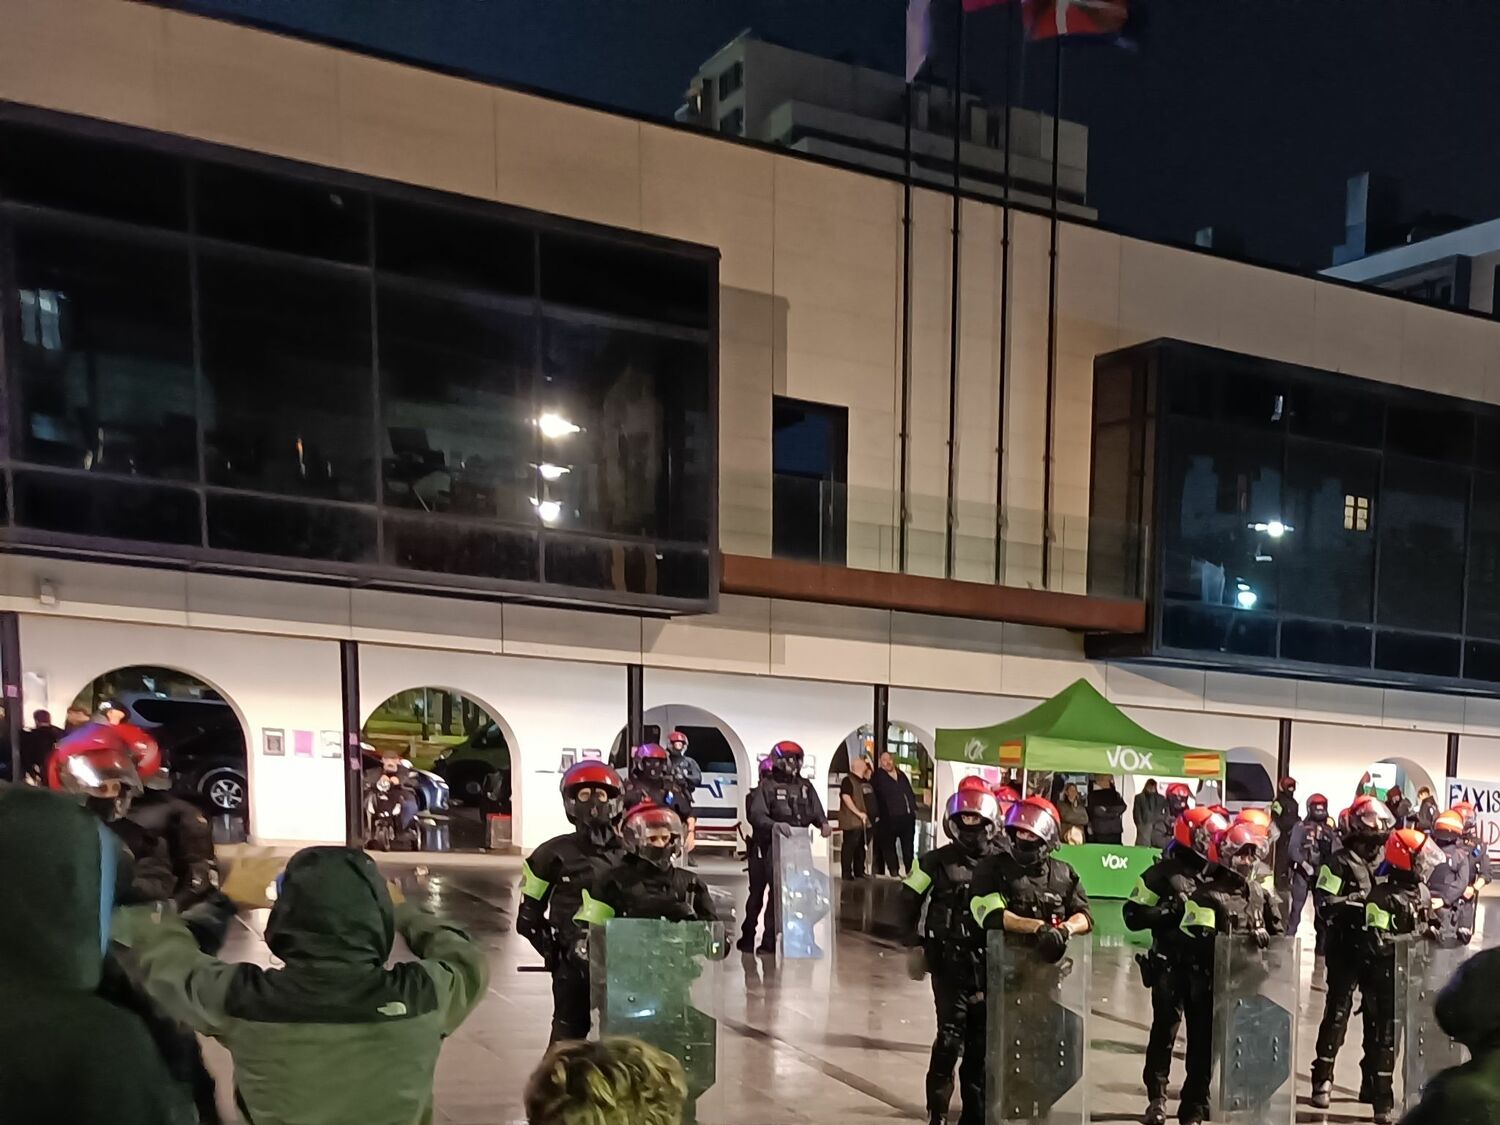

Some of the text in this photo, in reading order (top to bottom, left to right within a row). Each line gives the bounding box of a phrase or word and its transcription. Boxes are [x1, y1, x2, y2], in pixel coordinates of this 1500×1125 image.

[963, 737, 988, 761] VOX
[1106, 745, 1153, 771] VOX
[1101, 852, 1129, 870] VOX
